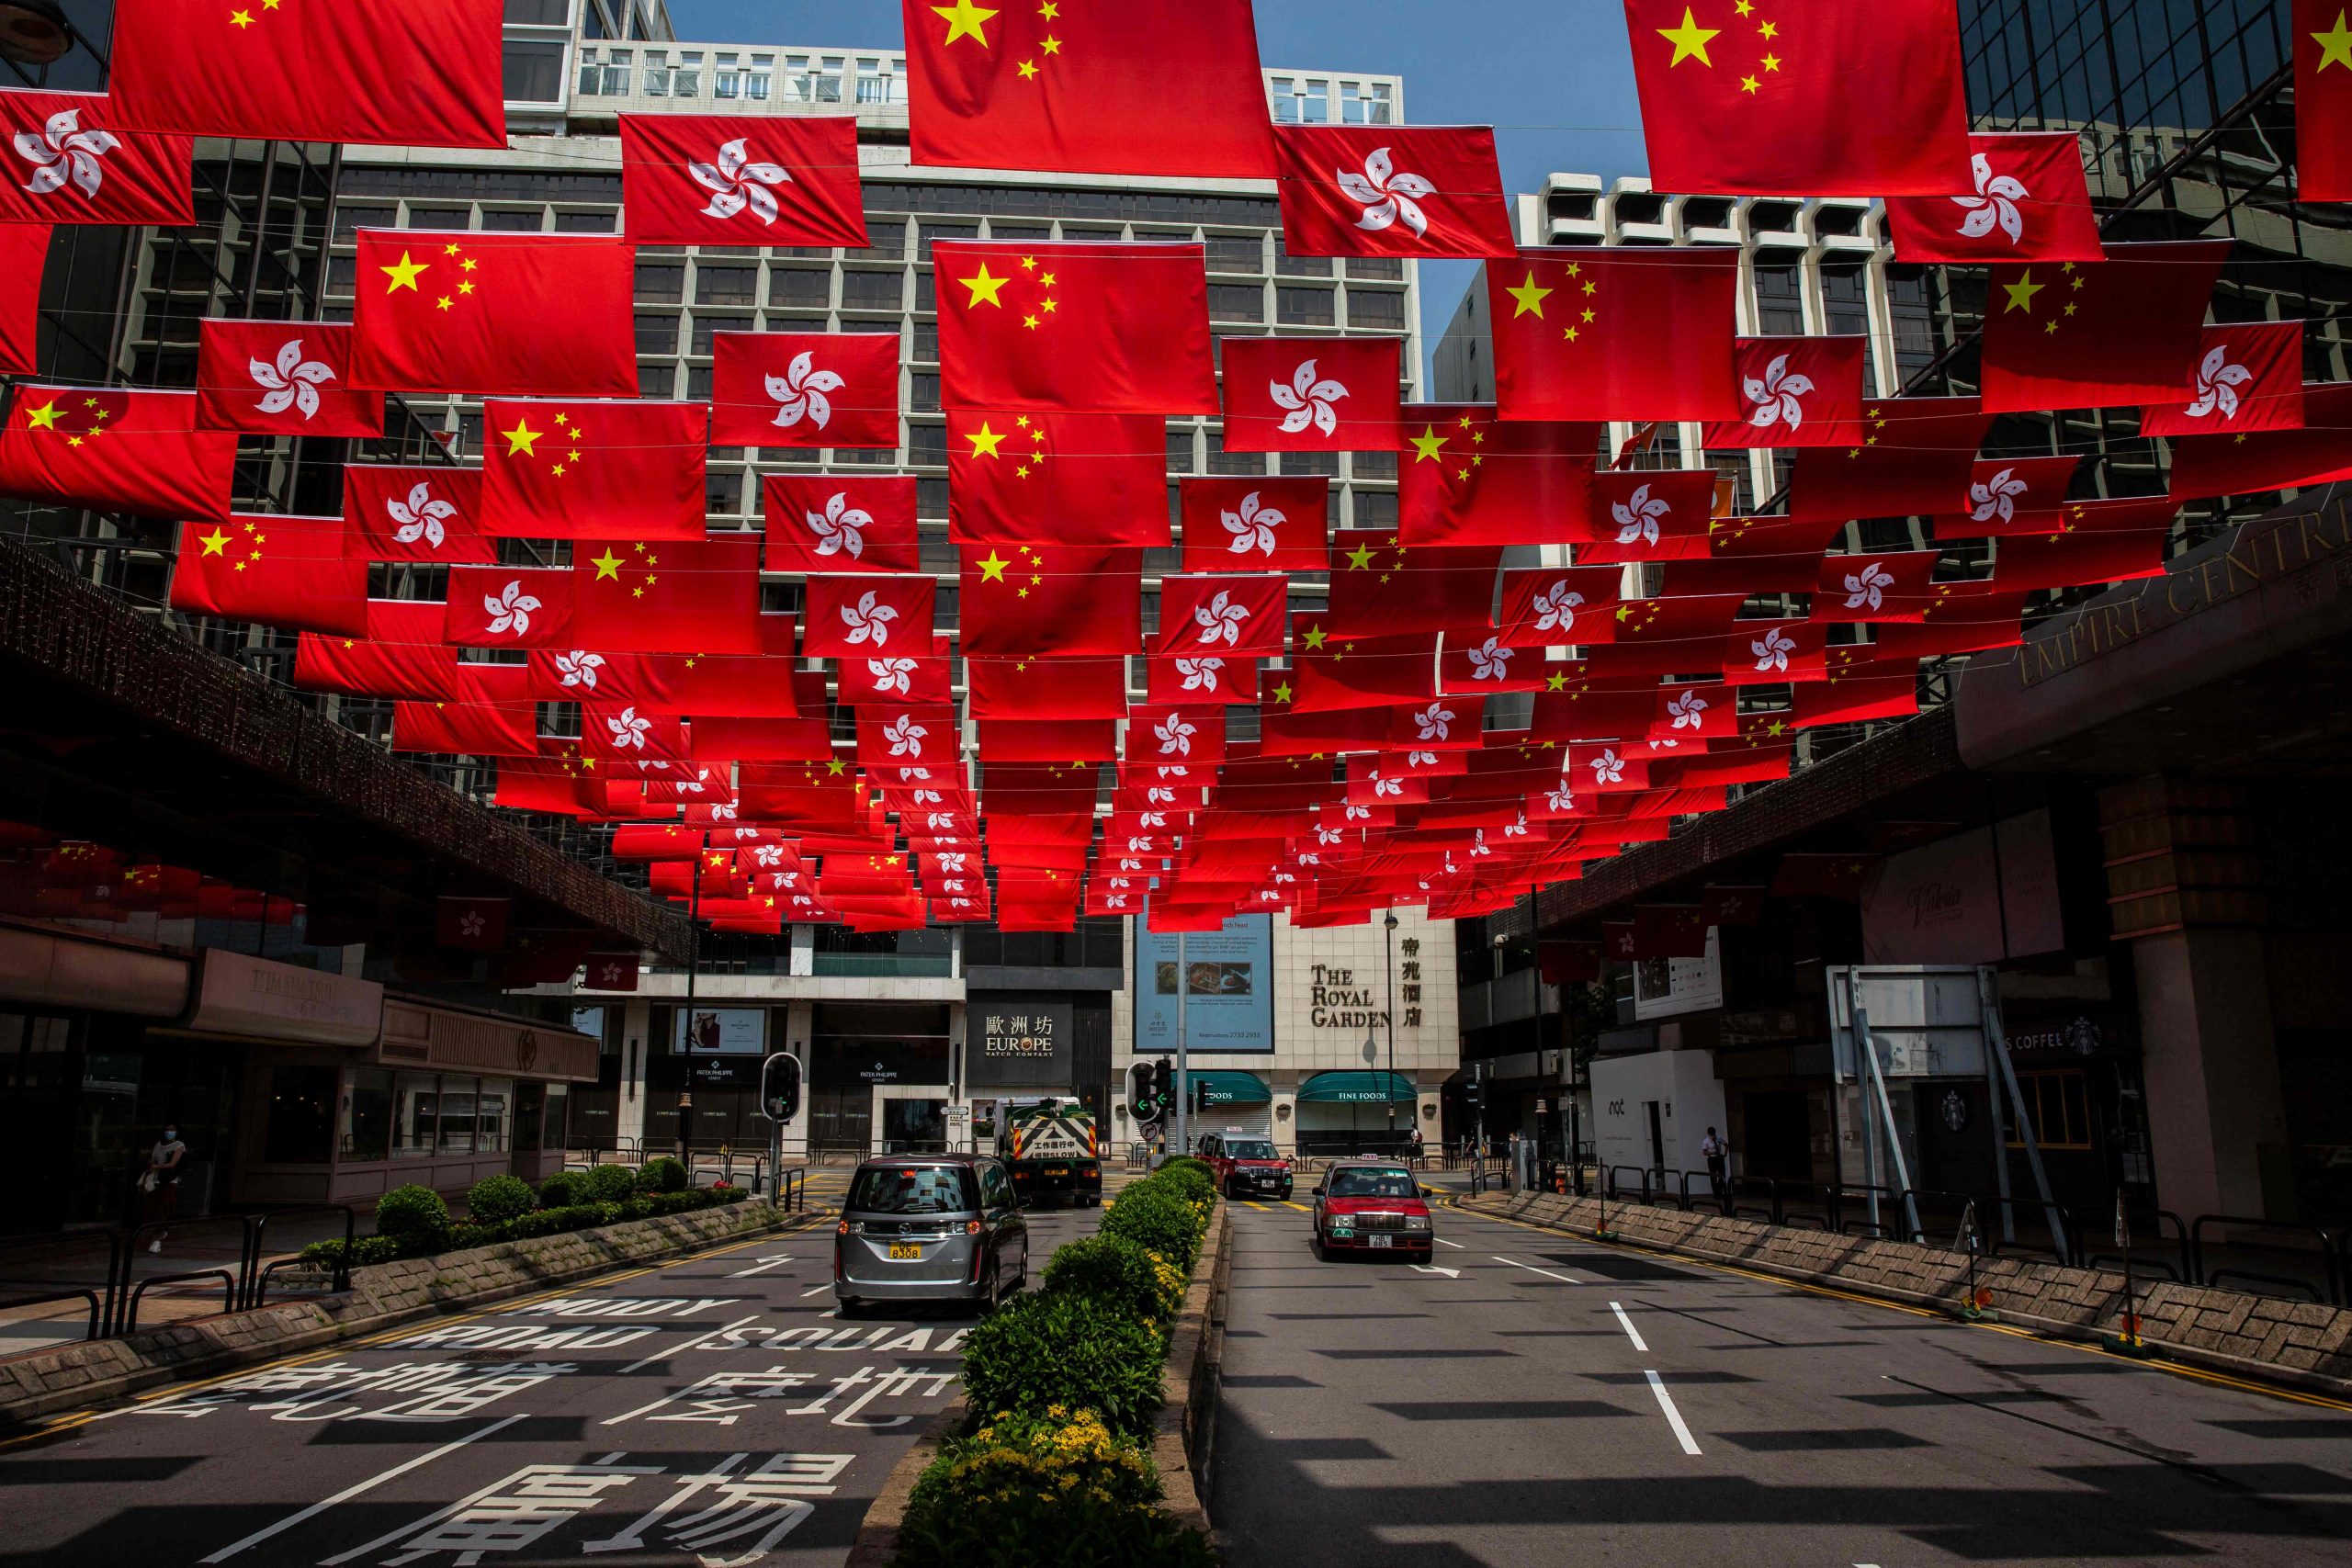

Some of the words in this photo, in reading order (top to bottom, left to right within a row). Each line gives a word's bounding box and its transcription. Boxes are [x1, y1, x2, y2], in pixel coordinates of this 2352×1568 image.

[2018, 592, 2150, 684] EMPIRE
[1311, 964, 1353, 986] THE
[1401, 937, 1422, 1028] 帝苑酒店
[1311, 986, 1374, 1007] ROYAL
[986, 1015, 1054, 1035] 歐洲坊
[1311, 1007, 1391, 1028] GARDEN
[986, 1037, 1054, 1052] EUROPE
[2016, 1032, 2064, 1050] COFFEE
[1339, 1092, 1357, 1100] FINE
[1359, 1092, 1386, 1100] FOODS
[1034, 1141, 1075, 1150] 工作進行中
[892, 1249, 918, 1258] 8308
[899, 1242, 912, 1250] DE
[498, 1299, 740, 1316] MODY
[375, 1325, 661, 1349] ROAD
[315, 1451, 857, 1568] 廣場
